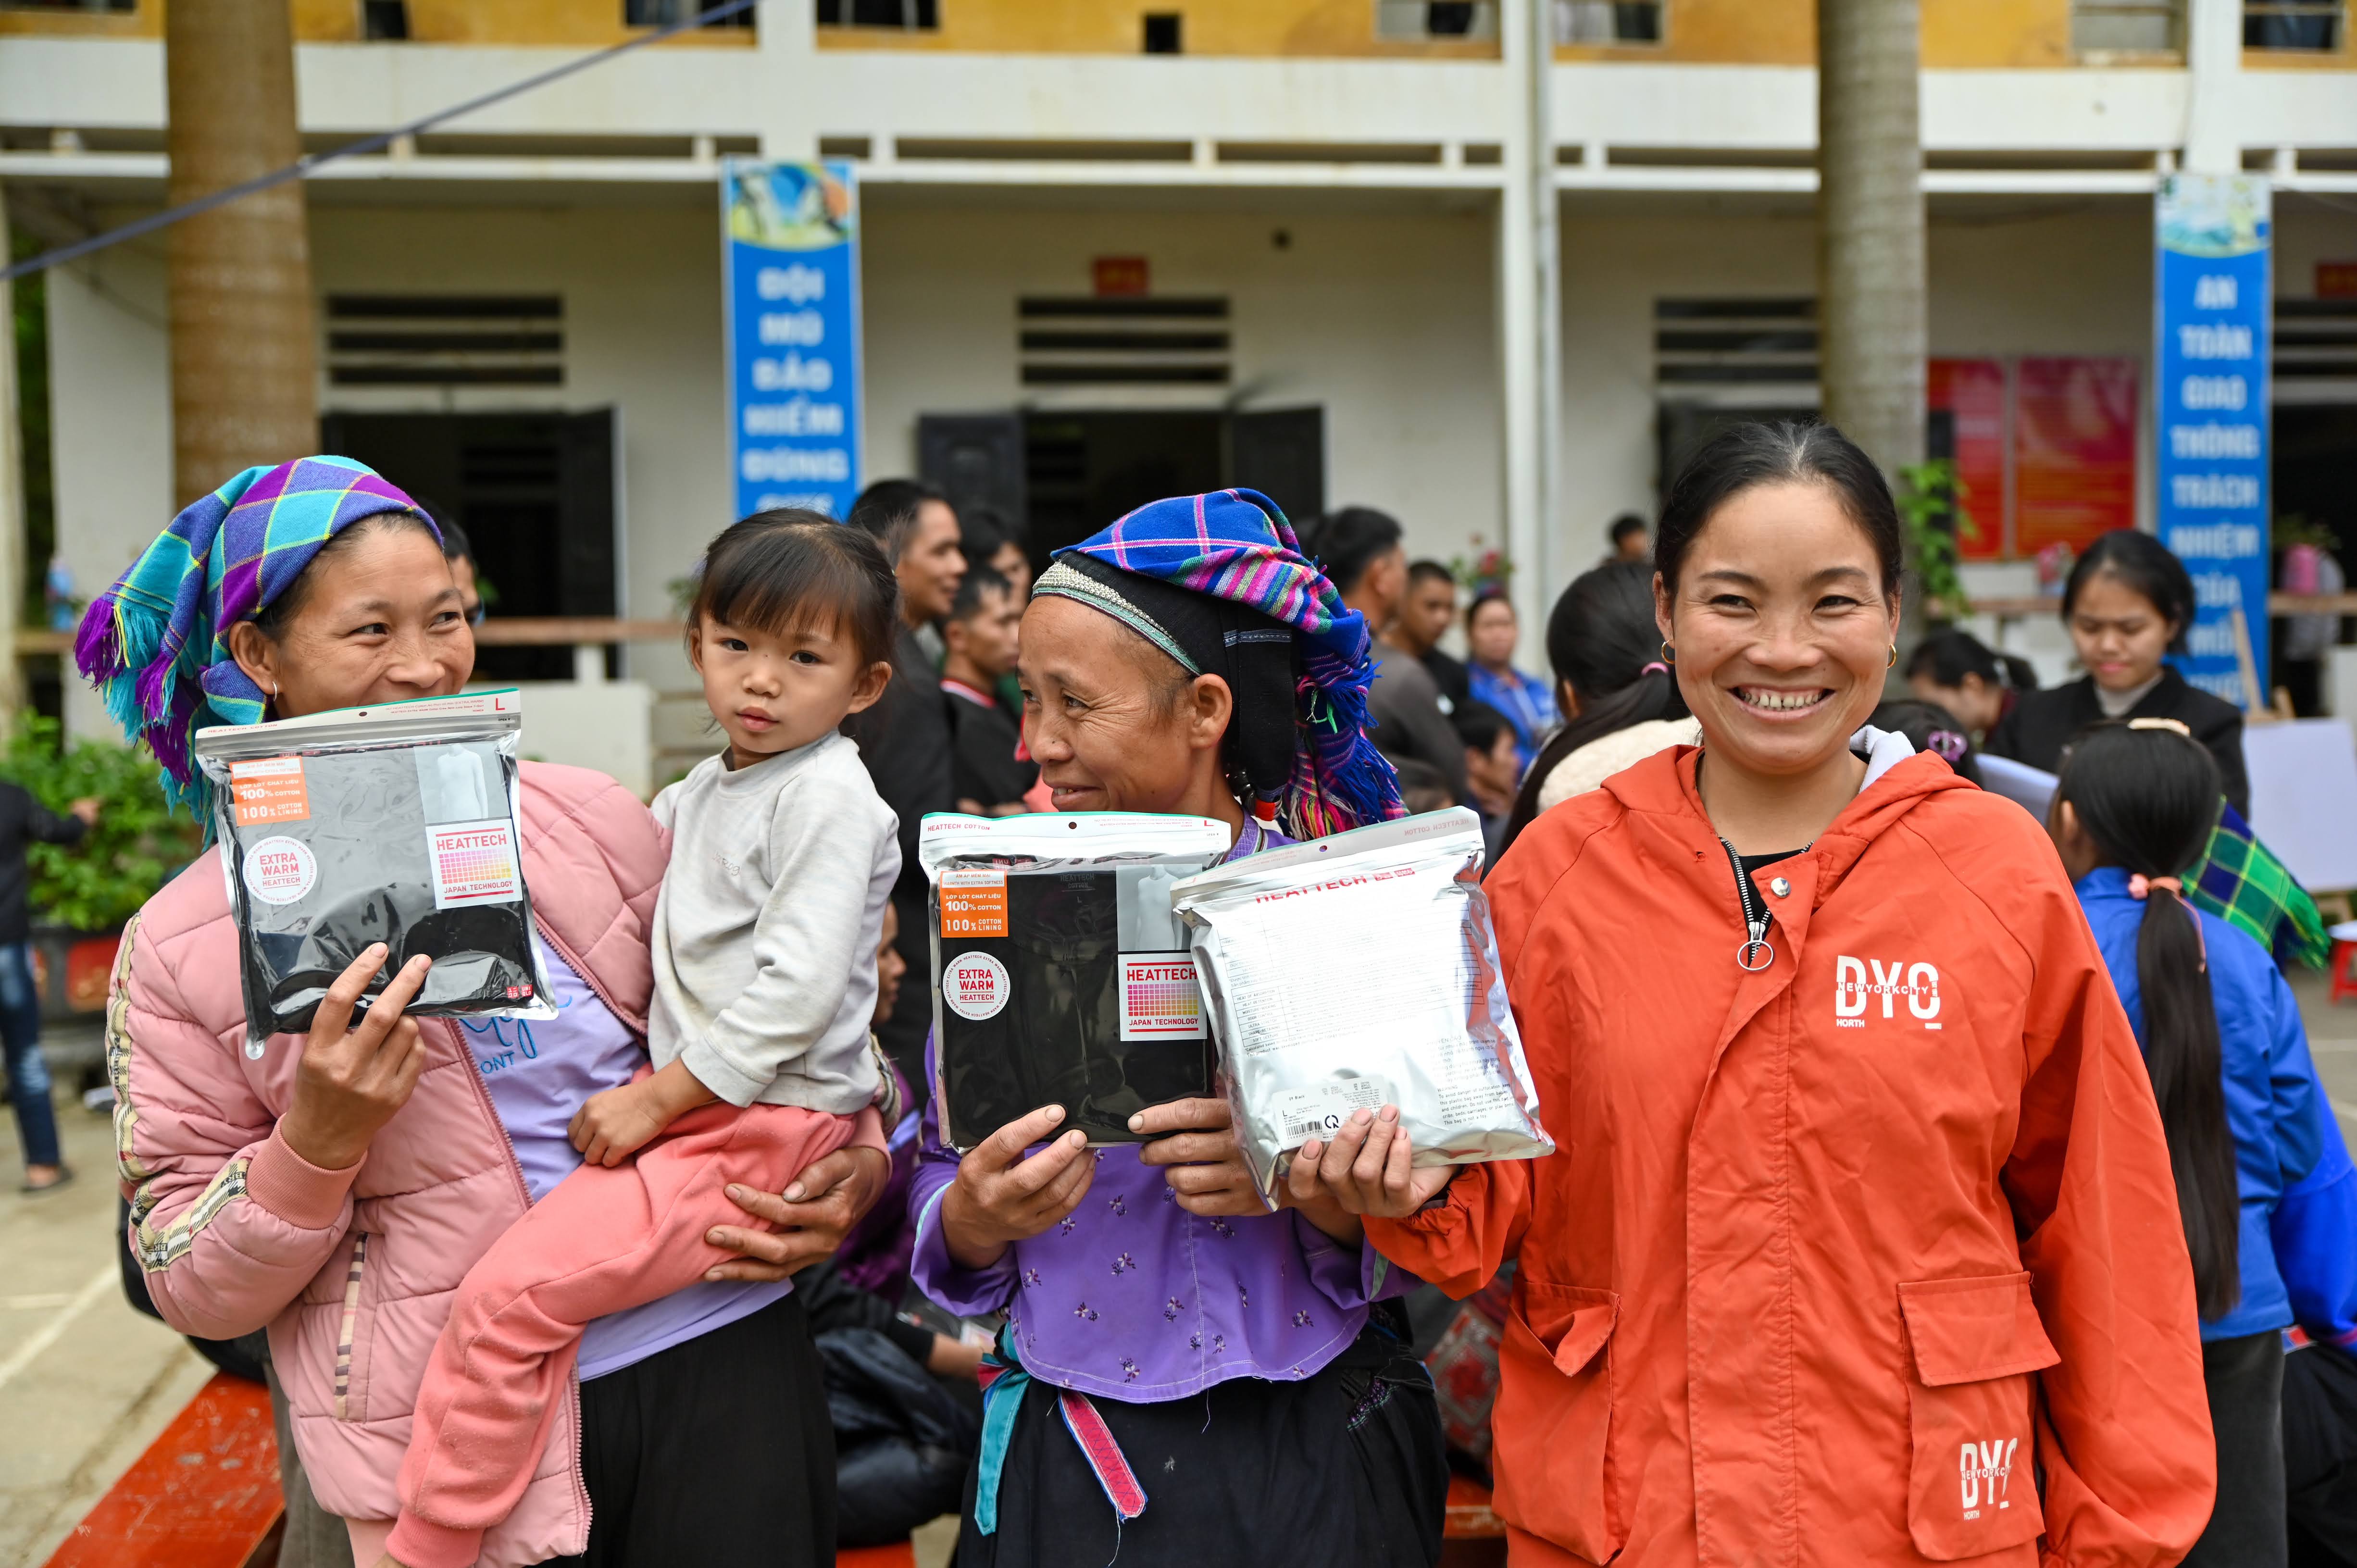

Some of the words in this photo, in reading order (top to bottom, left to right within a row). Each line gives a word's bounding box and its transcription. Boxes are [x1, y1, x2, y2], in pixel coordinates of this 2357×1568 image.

[2194, 274, 2238, 310] AN
[2178, 319, 2253, 360] TOÀN
[2181, 374, 2248, 411] GIAO
[2170, 421, 2260, 459] THÔNG
[2170, 471, 2258, 509] TRÁCH
[2169, 519, 2259, 561] NHIỆM
[496, 698, 505, 710] L
[240, 788, 274, 800] 100%
[242, 806, 275, 819] 100%
[928, 823, 961, 832] HEATTECH
[436, 834, 507, 851] HEATTECH
[260, 852, 298, 865] EXTRA
[262, 863, 299, 876] WARM
[262, 876, 300, 887] HEATTECH
[1060, 873, 1094, 882] HEATTECH
[444, 885, 466, 893] JAPAN
[470, 881, 512, 891] TECHNOLOGY
[946, 901, 976, 911] 100%
[946, 919, 976, 931] 100%
[953, 959, 962, 968] WARM
[994, 963, 1003, 973] WARM
[959, 969, 993, 979] EXTRA
[1127, 968, 1197, 981] HEATTECH
[959, 980, 994, 990] WARM
[950, 999, 959, 1009] WARM
[990, 1005, 1000, 1013] WARM
